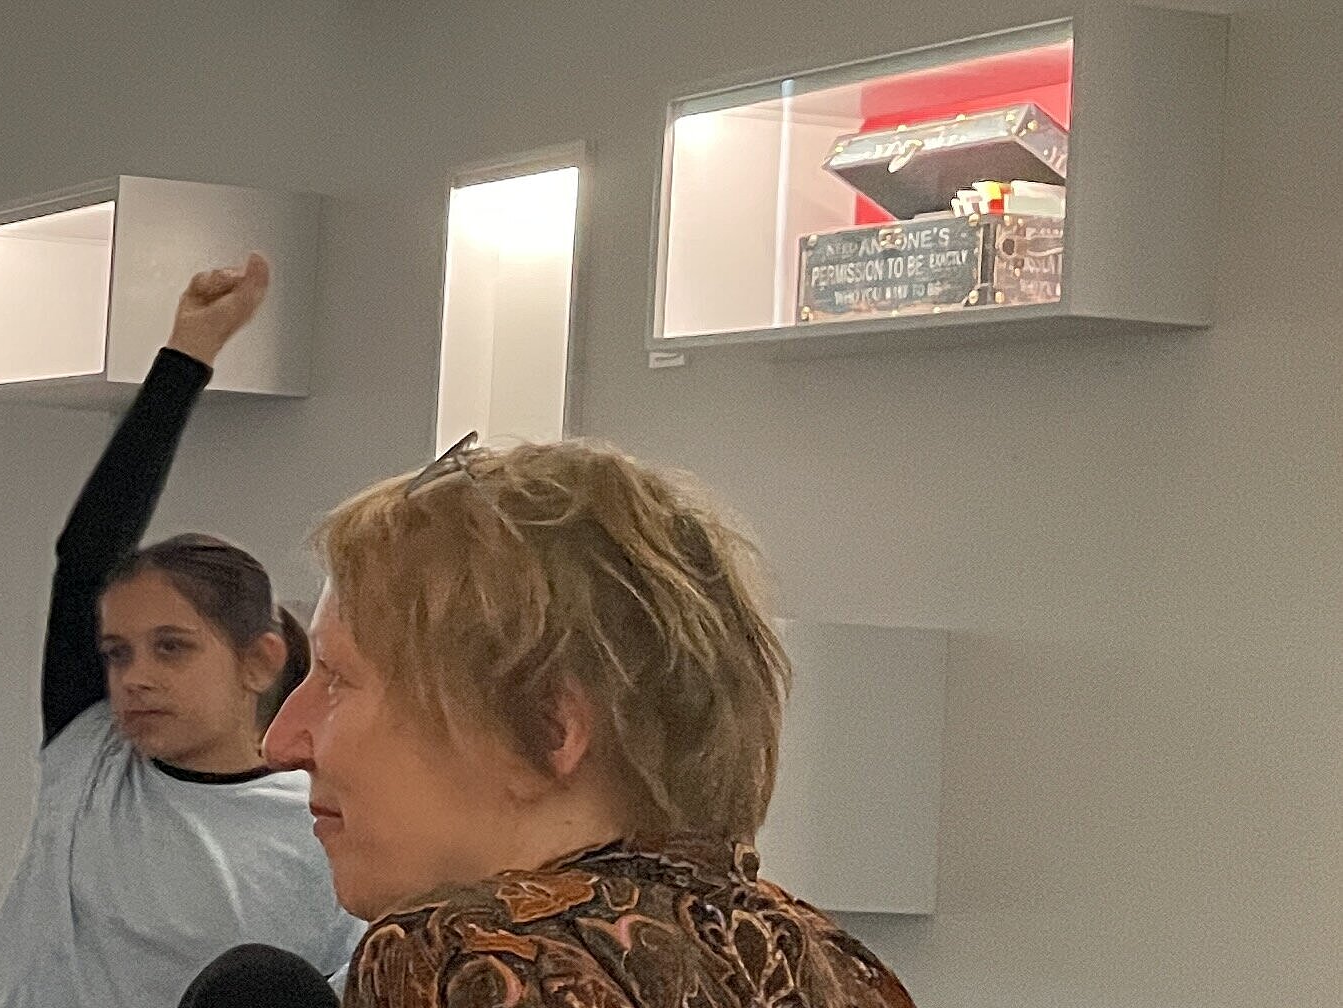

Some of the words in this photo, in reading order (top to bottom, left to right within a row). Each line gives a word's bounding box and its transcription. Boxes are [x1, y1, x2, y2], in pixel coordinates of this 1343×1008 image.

[811, 260, 884, 288] PERMISSION
[888, 256, 904, 280] TO
[907, 254, 925, 278] BE
